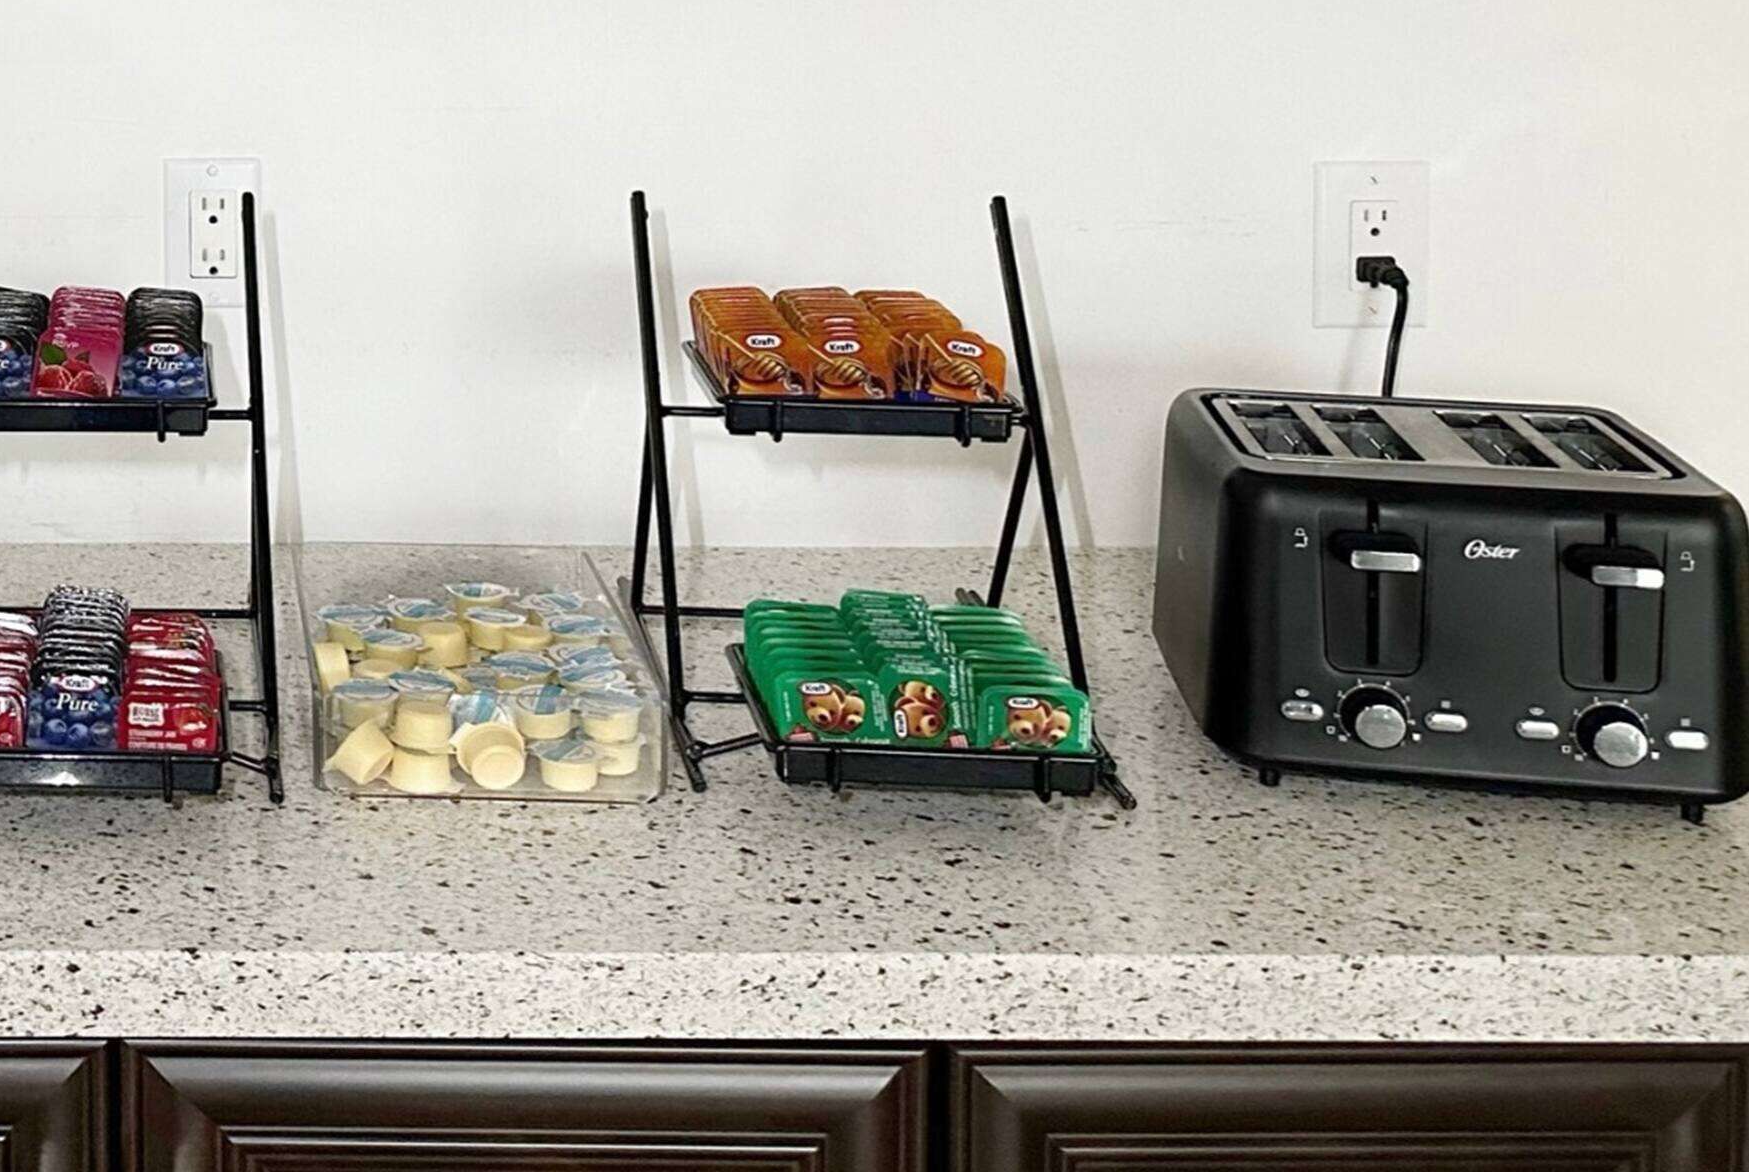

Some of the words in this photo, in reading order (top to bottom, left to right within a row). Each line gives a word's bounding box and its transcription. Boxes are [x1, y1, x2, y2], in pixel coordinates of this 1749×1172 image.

[749, 335, 777, 348] Kraft
[828, 341, 857, 354] Kraft
[152, 343, 177, 354] Kraft
[950, 342, 978, 355] Kraft
[145, 355, 184, 371] Pure
[1464, 539, 1520, 560] Oster
[55, 692, 99, 711] Pure
